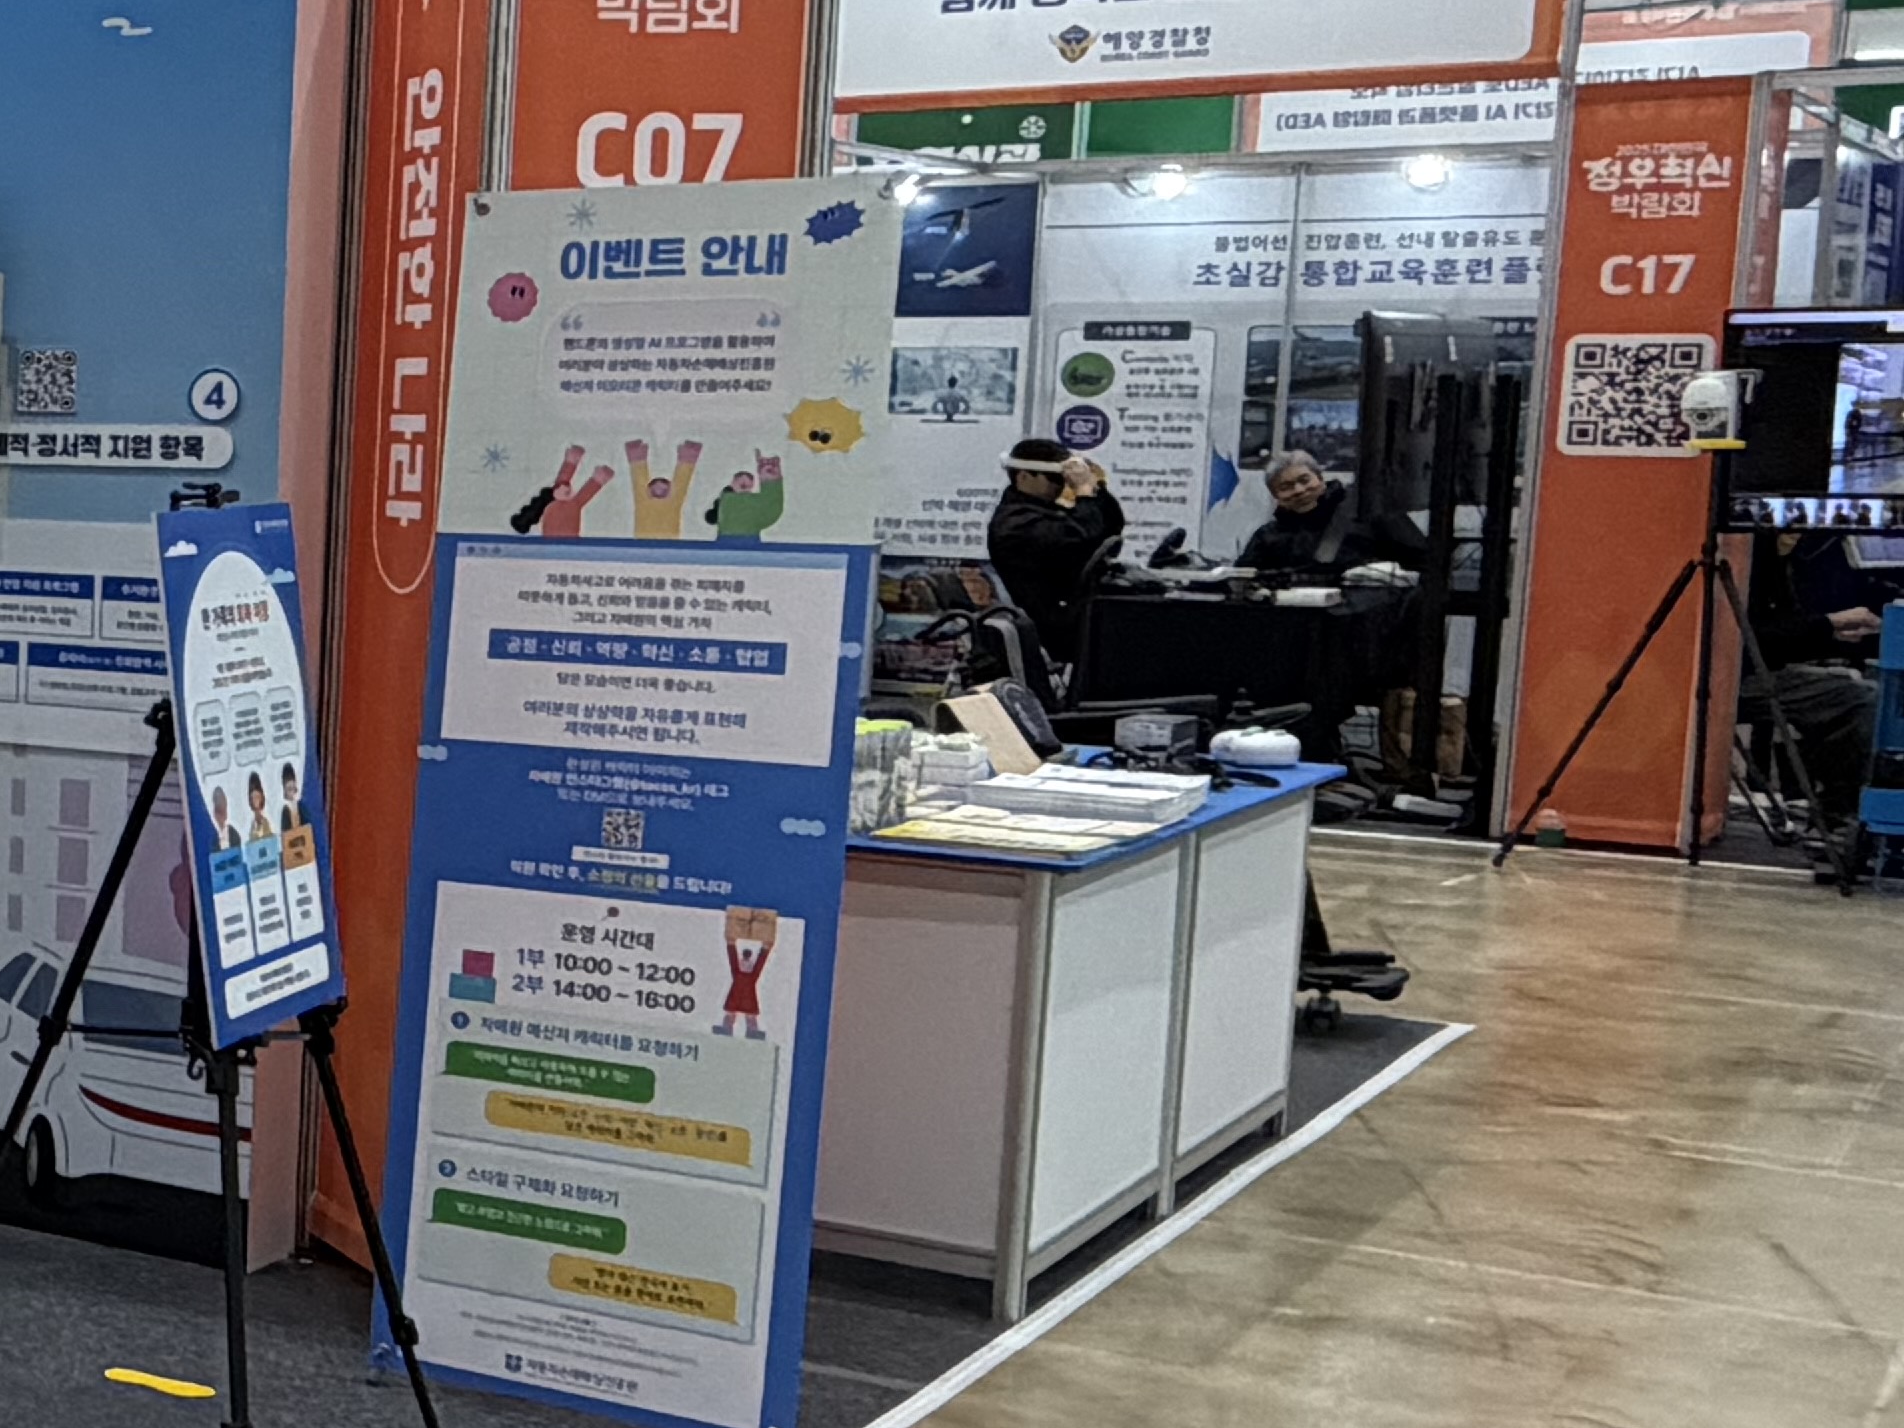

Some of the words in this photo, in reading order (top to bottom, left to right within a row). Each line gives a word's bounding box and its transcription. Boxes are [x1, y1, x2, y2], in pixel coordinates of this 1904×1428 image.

[1101, 25, 1212, 50] 해양경찰청
[576, 111, 743, 188] C07
[394, 67, 444, 330] 안전한
[1611, 191, 1701, 219] 박람회
[560, 237, 686, 280] 이벤트
[700, 232, 789, 277] 안내
[1396, 231, 1435, 249] 선내
[1193, 260, 1285, 287] 초실감
[1600, 254, 1696, 295] C17
[203, 381, 226, 409] 4
[108, 434, 152, 458] 지원
[159, 435, 204, 460] 항목
[385, 356, 428, 528] 나라
[560, 923, 596, 945] 운영
[601, 925, 655, 951] 시간대
[517, 948, 545, 968] 1부
[554, 952, 613, 976] 10:00
[635, 962, 695, 986] 12:00
[512, 974, 544, 995] 2부
[553, 979, 612, 1002] 14:00
[635, 989, 695, 1013] 16:00
